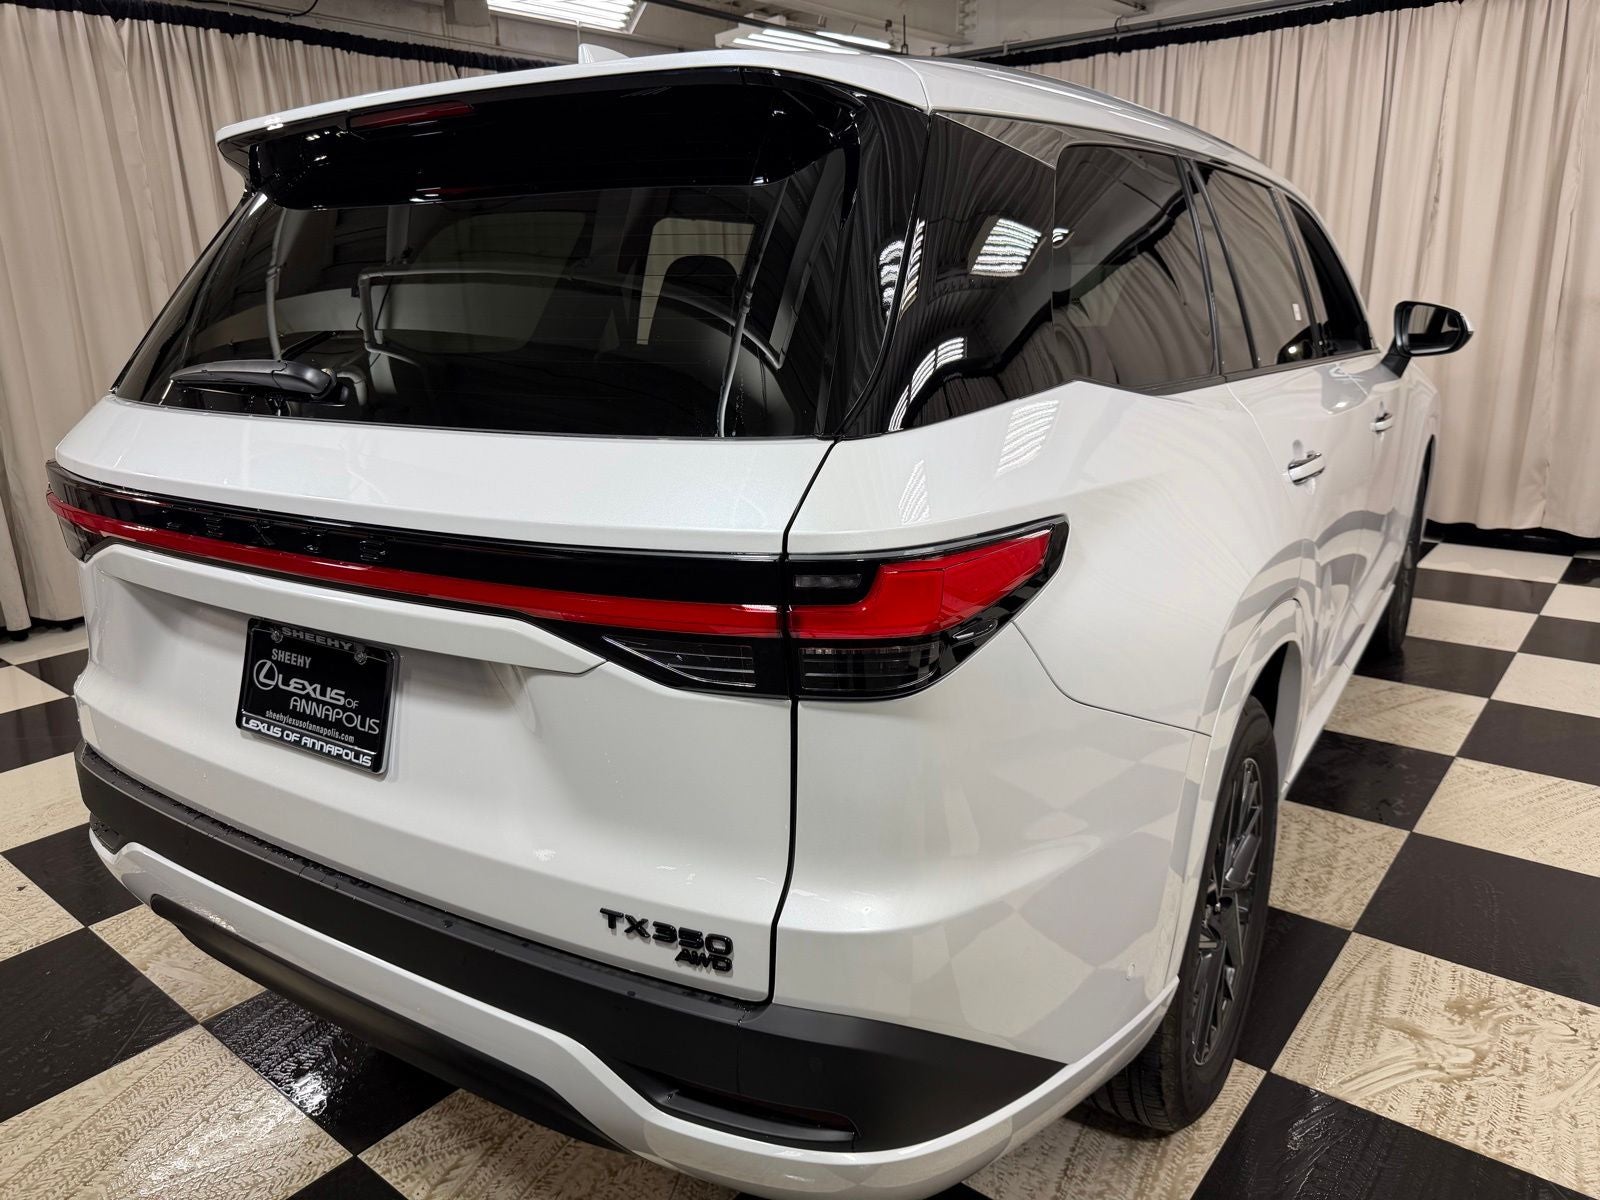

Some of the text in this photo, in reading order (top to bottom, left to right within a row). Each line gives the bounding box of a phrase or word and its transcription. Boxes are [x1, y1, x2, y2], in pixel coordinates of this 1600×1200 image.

[281, 626, 353, 650] SHEEHY
[271, 648, 312, 669] SHEEHY
[278, 673, 360, 709] LEXUS OF
[265, 709, 355, 743] sheehylexusofannapolis.com
[289, 696, 380, 735] ANNAPOLIS
[242, 716, 372, 767] LEXUS OF ANNAPOLIS
[674, 948, 733, 972] AWD
